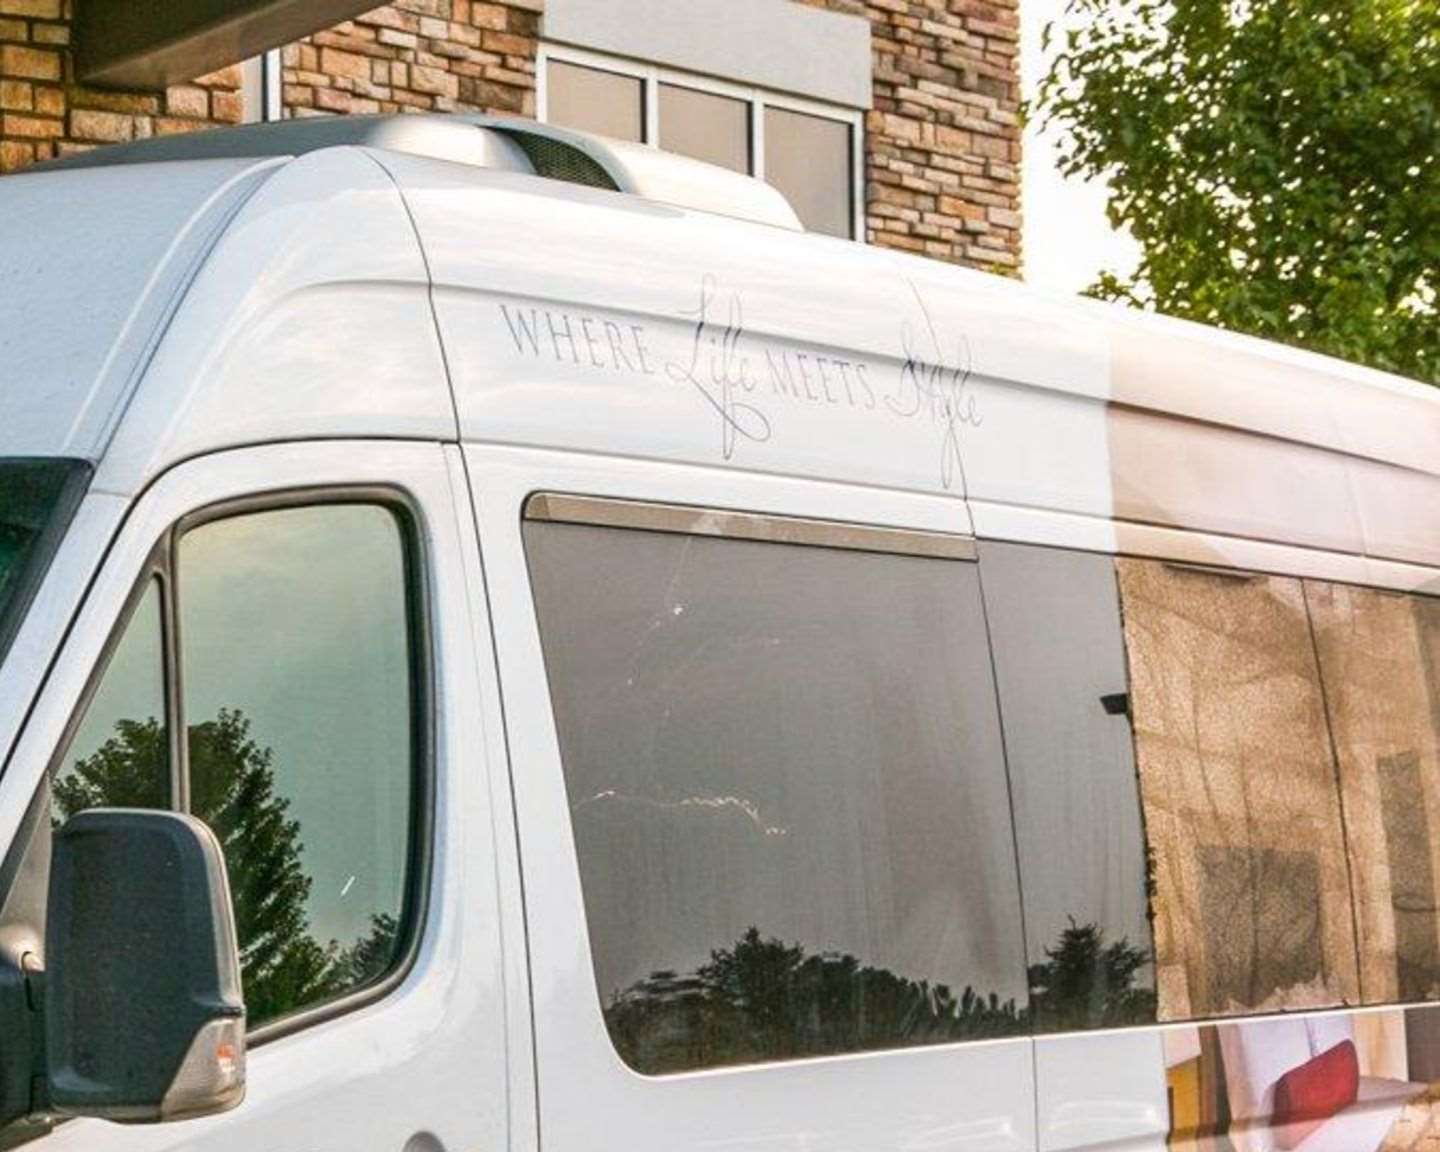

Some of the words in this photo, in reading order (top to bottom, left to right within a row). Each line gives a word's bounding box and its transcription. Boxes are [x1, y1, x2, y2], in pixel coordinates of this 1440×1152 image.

[500, 304, 655, 376] WHERE
[665, 271, 772, 461] Life
[765, 348, 876, 411] MEETS
